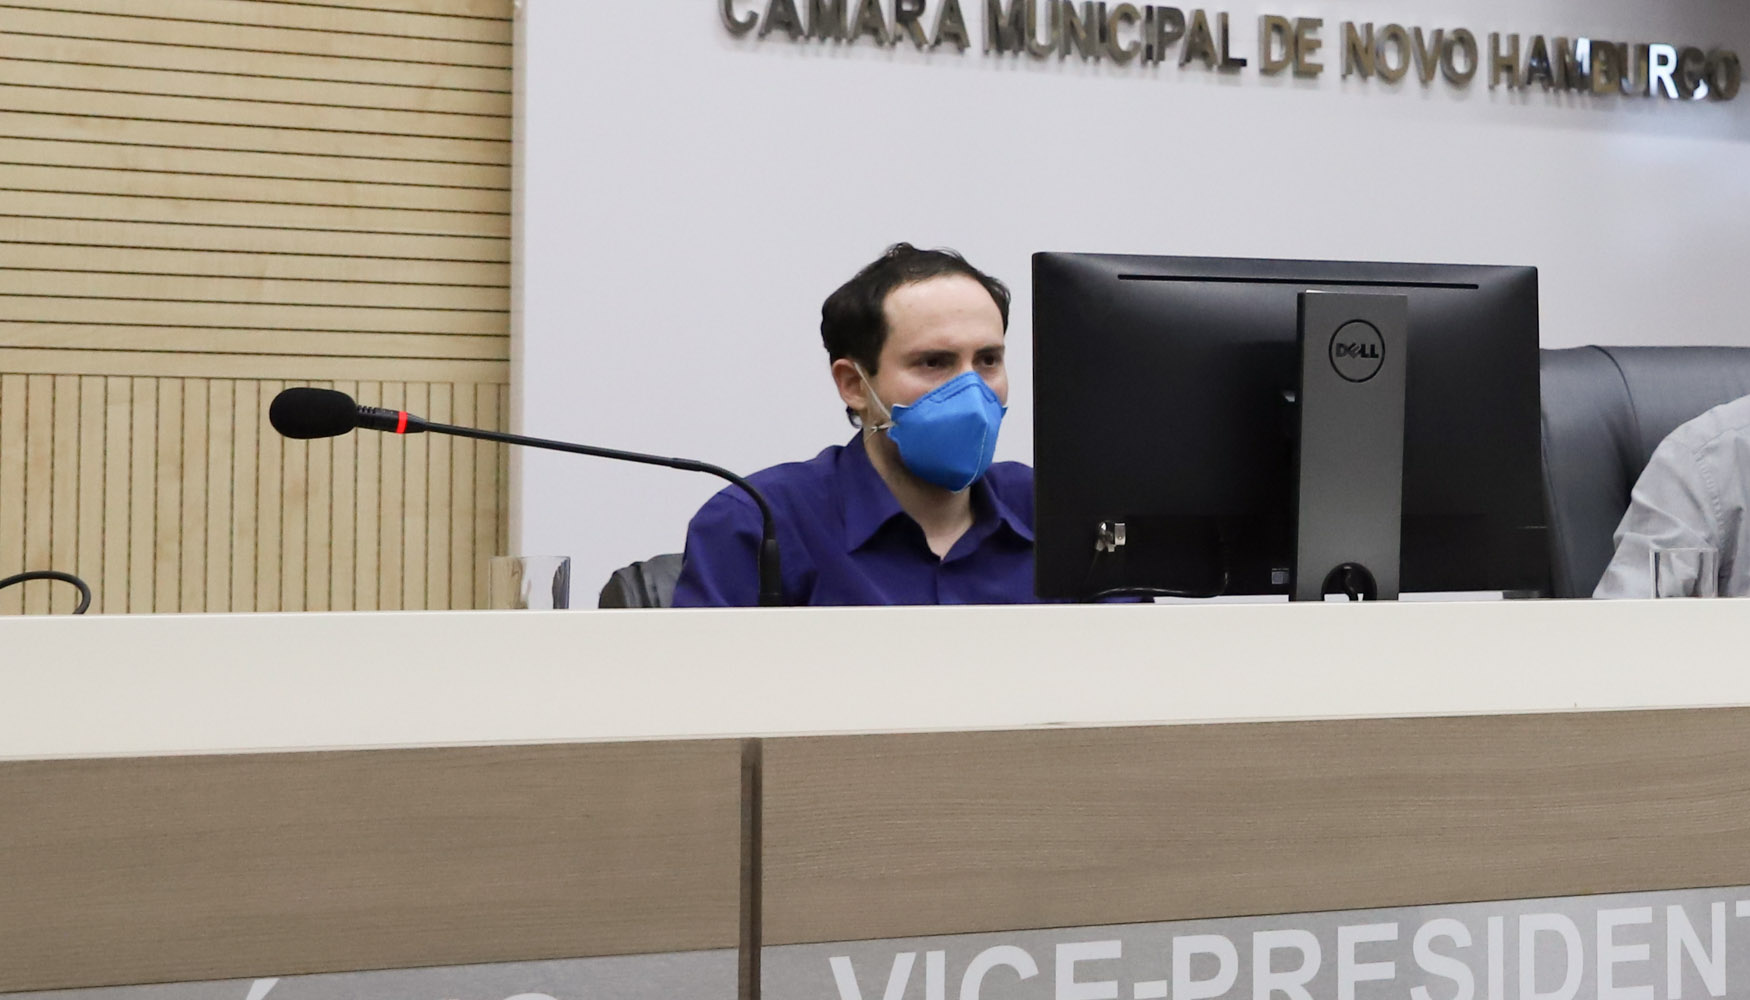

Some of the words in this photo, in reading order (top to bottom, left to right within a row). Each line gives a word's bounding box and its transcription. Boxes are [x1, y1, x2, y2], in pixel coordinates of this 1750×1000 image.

[1259, 14, 1324, 78] DE
[1341, 21, 1478, 85] NOVO
[1488, 32, 1742, 102] HAMBURGO
[1336, 342, 1379, 359] DELL
